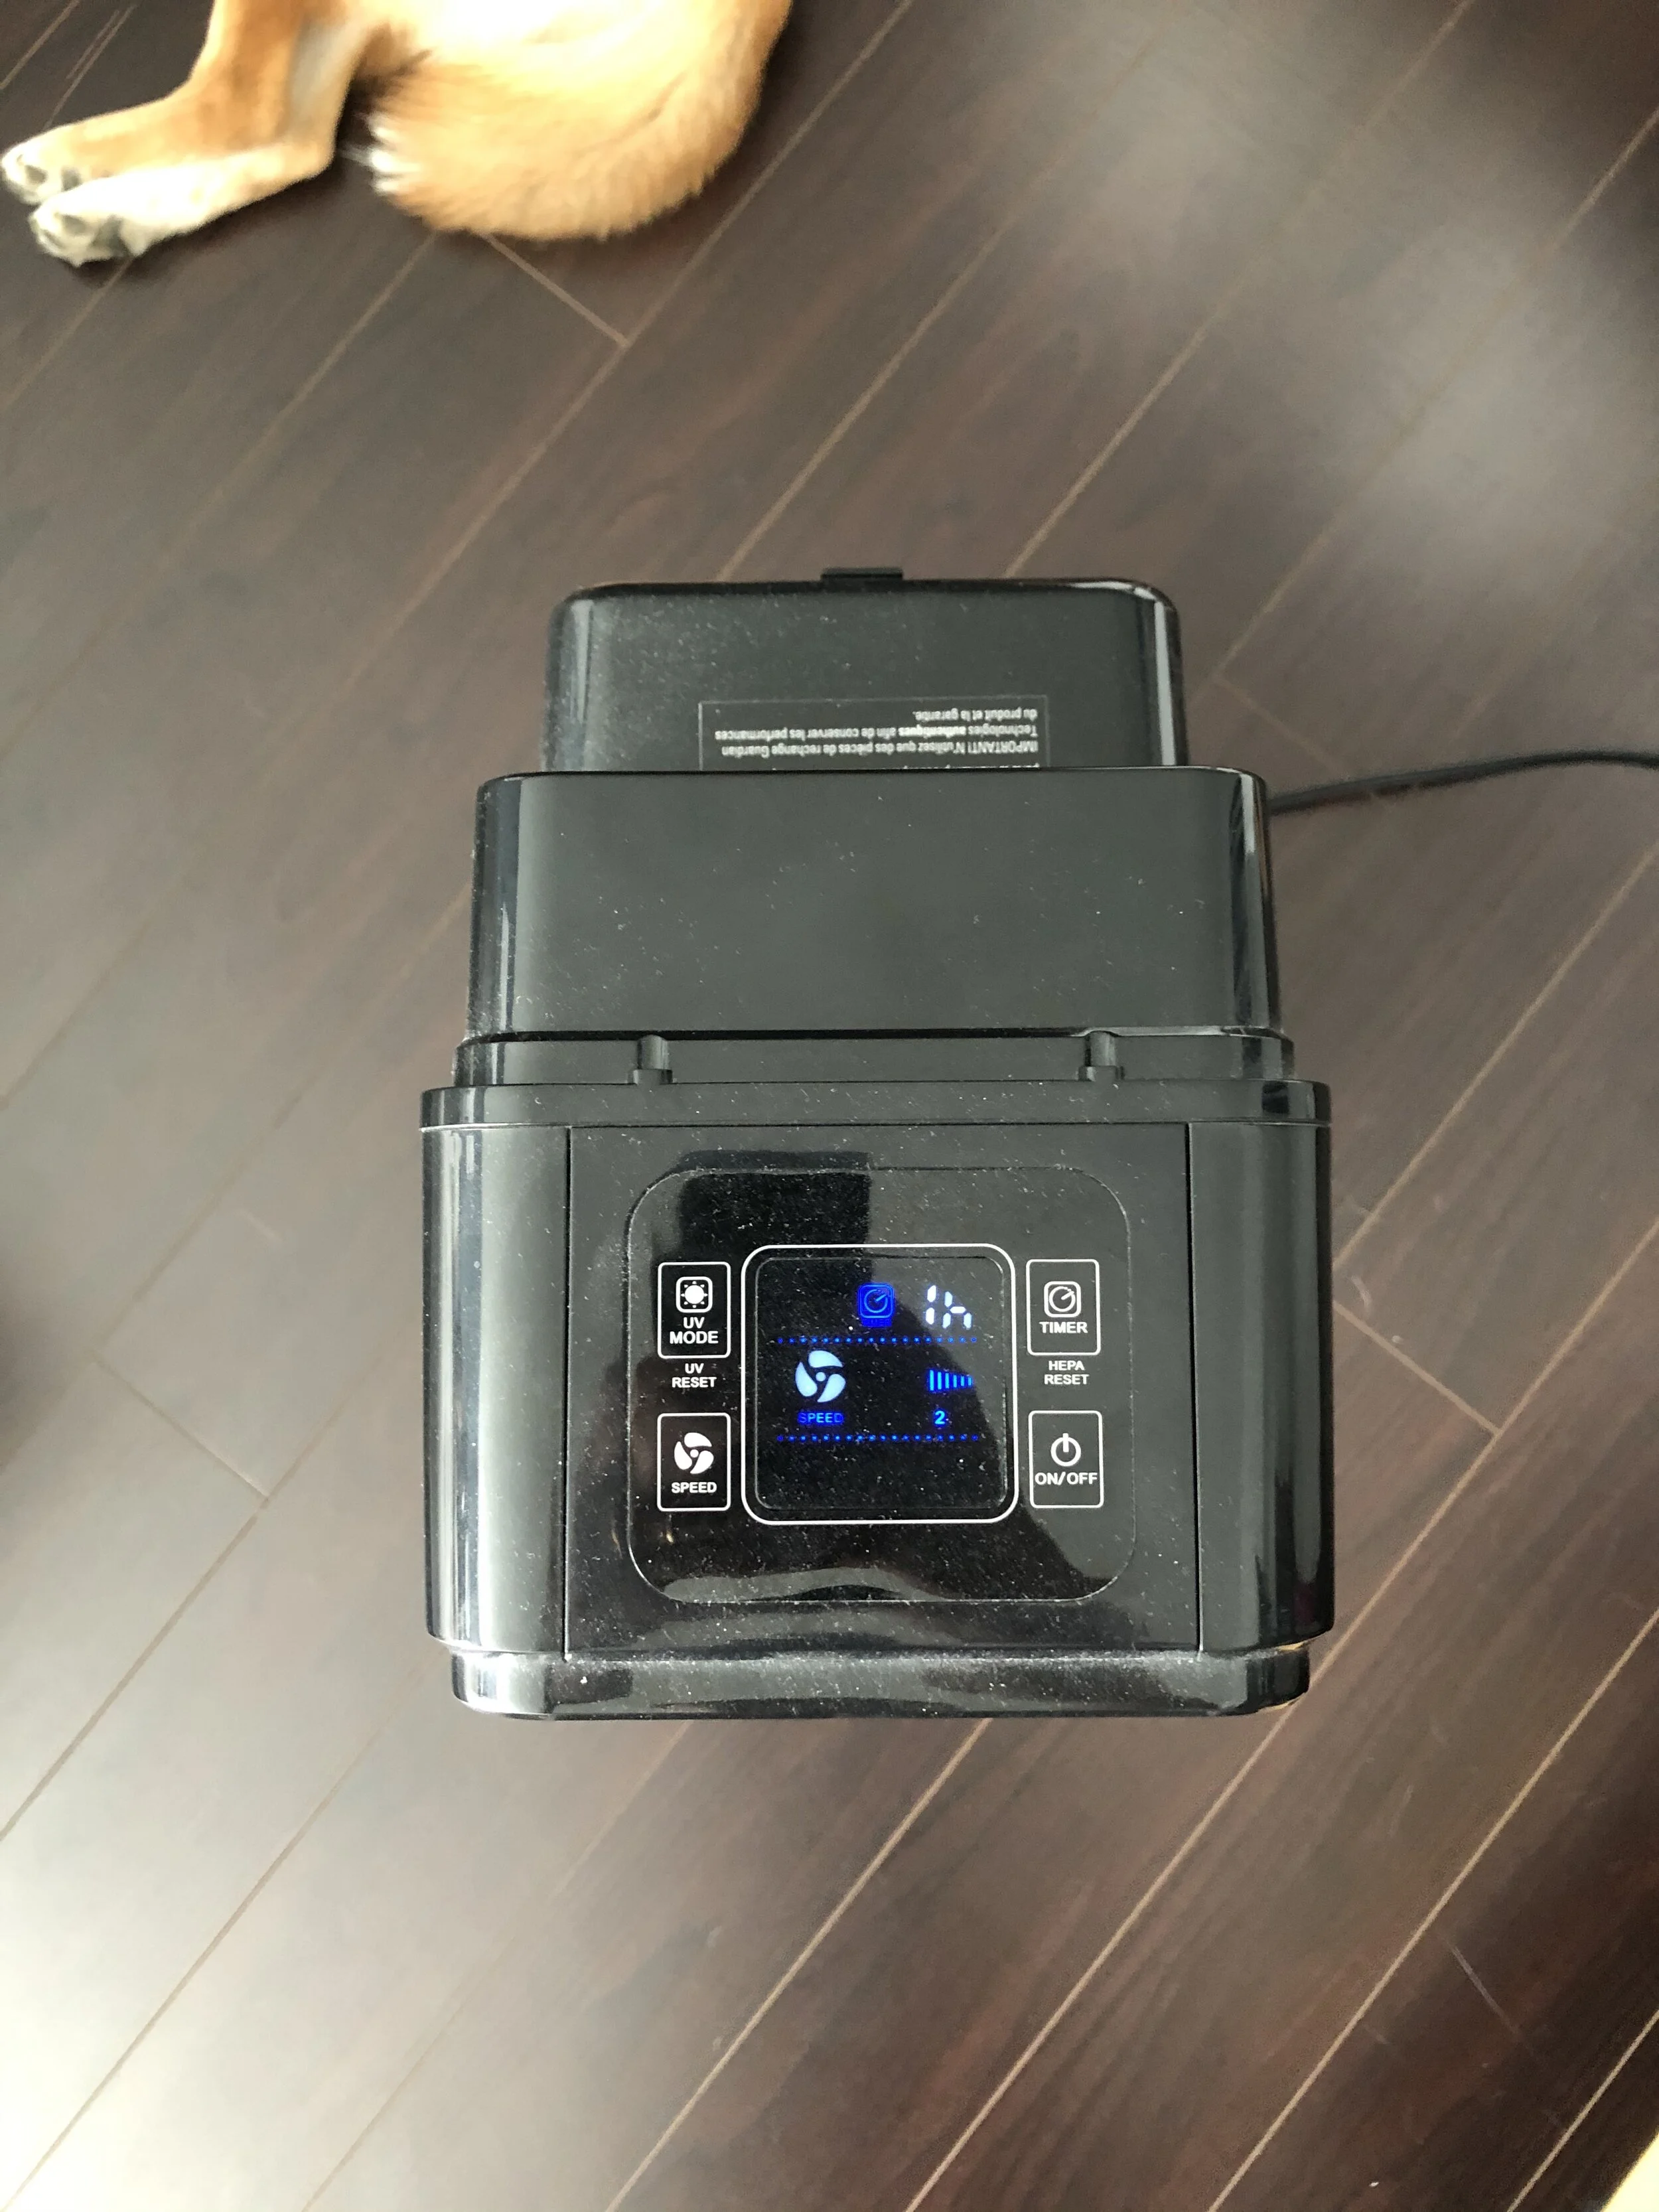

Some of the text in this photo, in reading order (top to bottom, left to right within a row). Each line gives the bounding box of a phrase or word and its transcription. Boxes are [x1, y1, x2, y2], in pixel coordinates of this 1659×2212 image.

[960, 710, 971, 722] la
[972, 710, 983, 721] et
[984, 706, 1021, 721] produit
[1023, 709, 1038, 721] du
[715, 723, 1038, 741] Technologies authentiques afin de conserver les performances
[721, 745, 770, 759] Guardian
[771, 743, 822, 757] rechange
[823, 745, 836, 757] de
[875, 743, 895, 755] des
[897, 741, 916, 752] que
[683, 1317, 705, 1329] UV
[1039, 1321, 1088, 1334] TIMER
[670, 1330, 719, 1345] MODE
[684, 1363, 704, 1374] UV
[1048, 1360, 1086, 1372] HEPA
[672, 1376, 717, 1388] RESET
[1044, 1373, 1090, 1386] RESET
[798, 1412, 843, 1425] SPEED
[934, 1410, 946, 1426] 2
[1034, 1471, 1098, 1486] ON/OFF
[671, 1481, 717, 1494] SPEED
